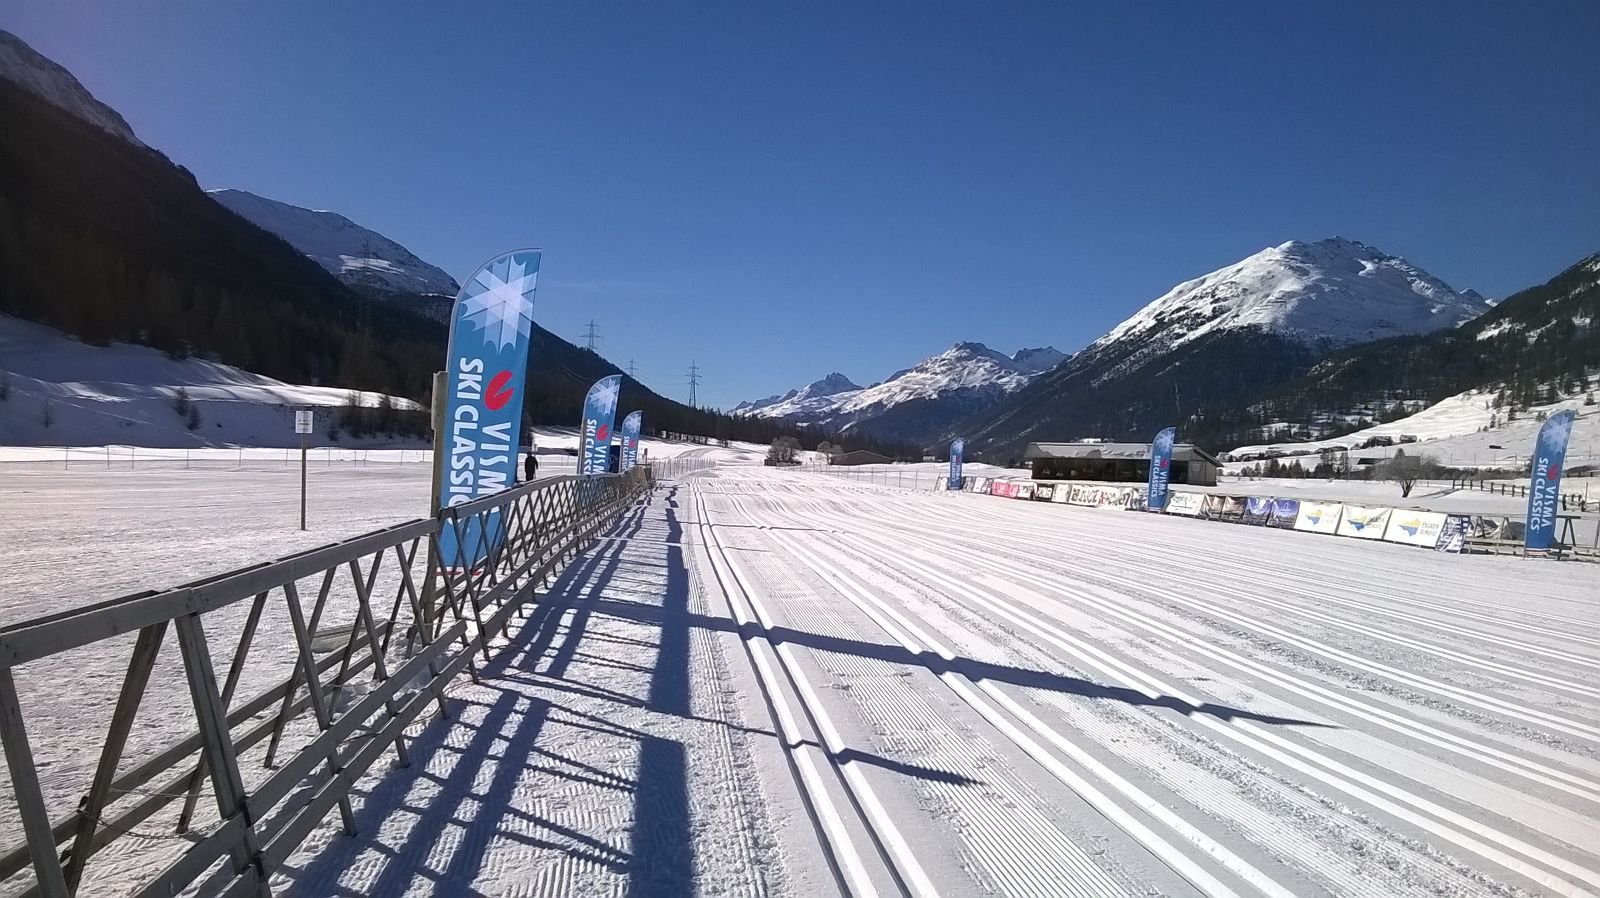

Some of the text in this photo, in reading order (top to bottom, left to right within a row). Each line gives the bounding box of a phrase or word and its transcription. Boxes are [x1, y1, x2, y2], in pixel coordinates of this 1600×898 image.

[457, 357, 484, 400] SKI
[586, 419, 597, 437] SKI
[476, 422, 512, 517] VISM
[592, 445, 607, 474] VISM
[1151, 467, 1160, 499] CLASSICS
[1159, 471, 1167, 496] VISMA
[1531, 457, 1549, 531] SKI CLASSICS
[1541, 485, 1556, 528] VISMA
